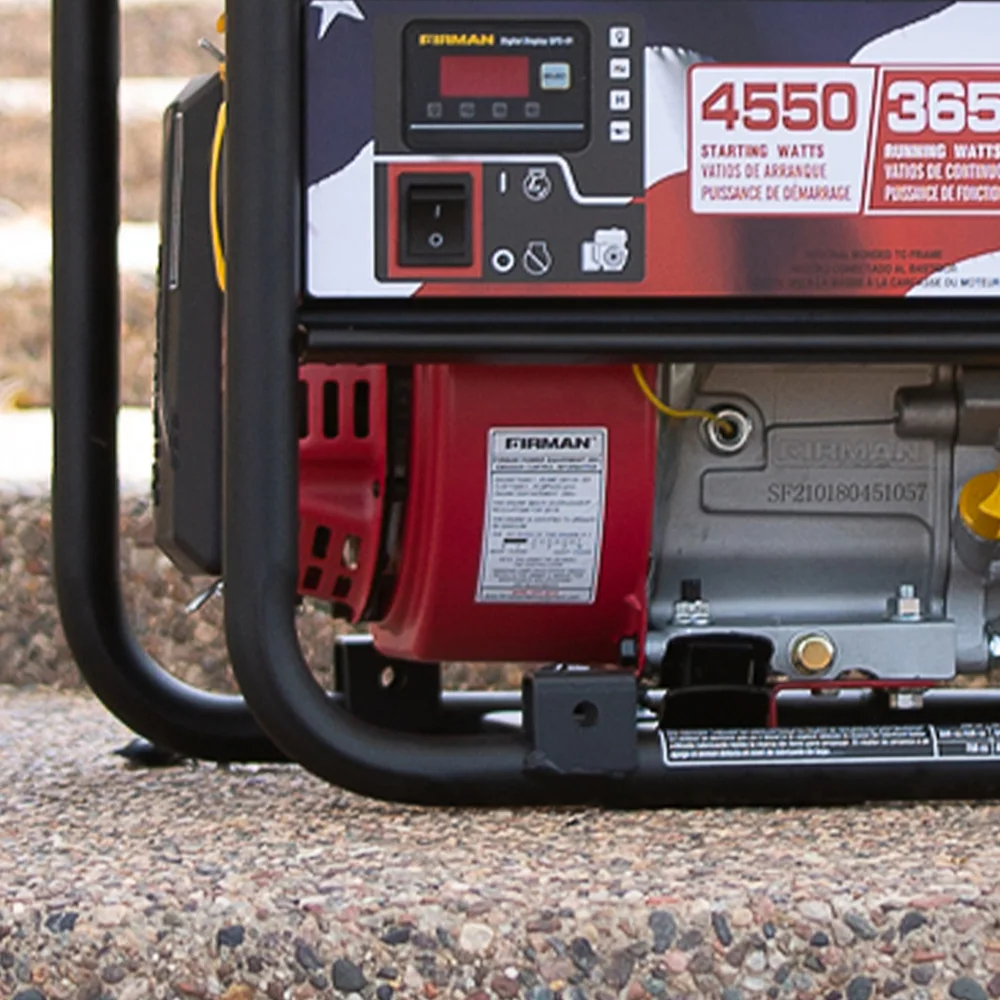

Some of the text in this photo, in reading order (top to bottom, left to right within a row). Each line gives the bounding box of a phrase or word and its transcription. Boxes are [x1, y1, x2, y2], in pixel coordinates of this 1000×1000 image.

[419, 33, 494, 46] FIRMAN
[702, 82, 857, 131] 4550
[700, 144, 824, 158] STARTING WATTS
[884, 143, 946, 159] RUNNING
[701, 163, 827, 179] VATIOS DE ARRANQUE
[884, 163, 924, 179] VATIOS
[927, 163, 942, 179] DE
[701, 185, 762, 200] PUISSANCE
[766, 185, 779, 200] DE
[941, 185, 955, 200] DE
[505, 437, 590, 450] FIRMAN
[767, 483, 928, 503] SF210180451057
